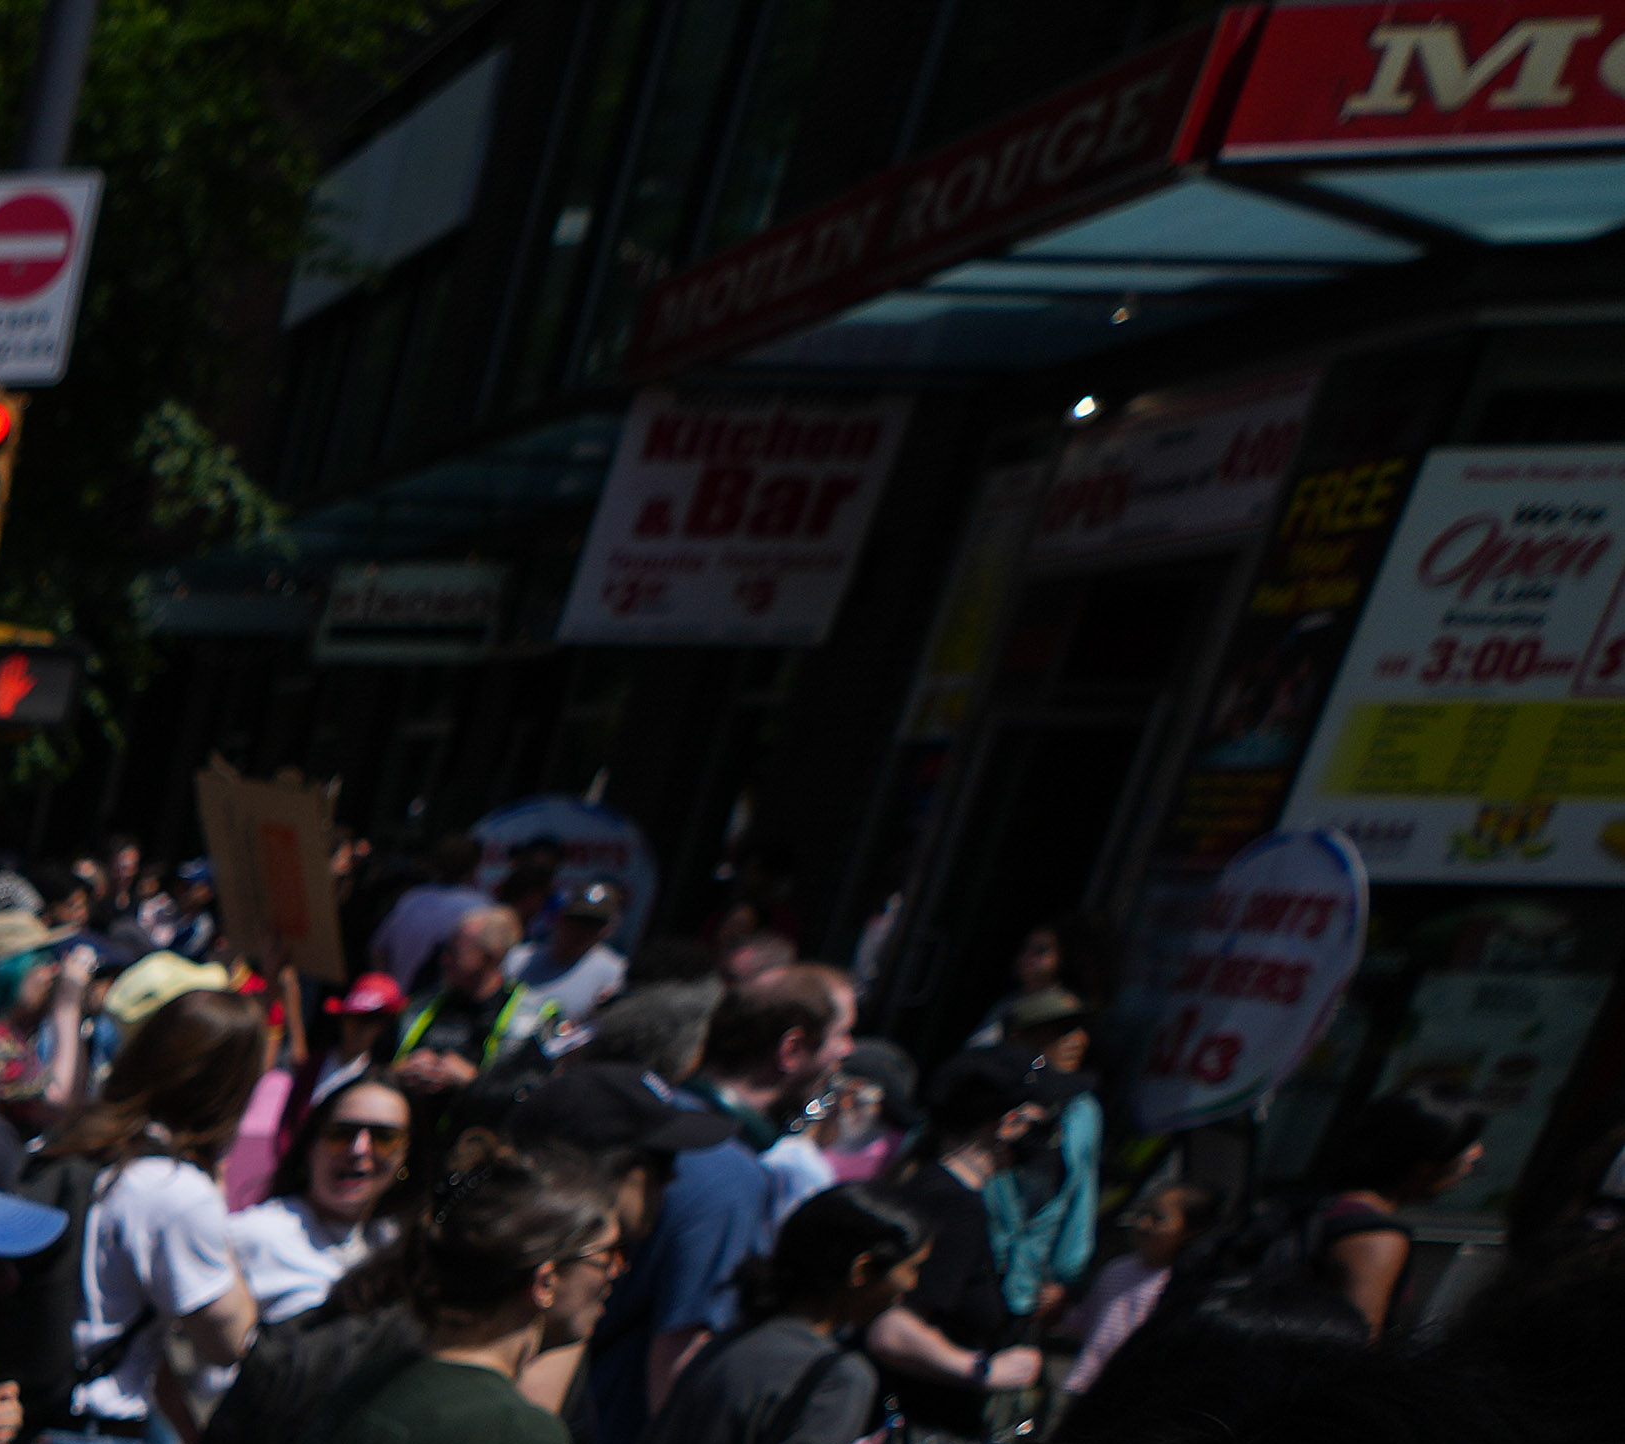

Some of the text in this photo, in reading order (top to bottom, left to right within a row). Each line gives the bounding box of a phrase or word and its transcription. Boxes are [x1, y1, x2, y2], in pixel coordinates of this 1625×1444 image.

[1337, 14, 1625, 124] M
[660, 74, 1168, 333] MOULIN ROUGE
[641, 411, 883, 464] Kitchen
[683, 466, 862, 538] Bar
[1281, 456, 1407, 540] FREE
[1417, 511, 1615, 602] Open
